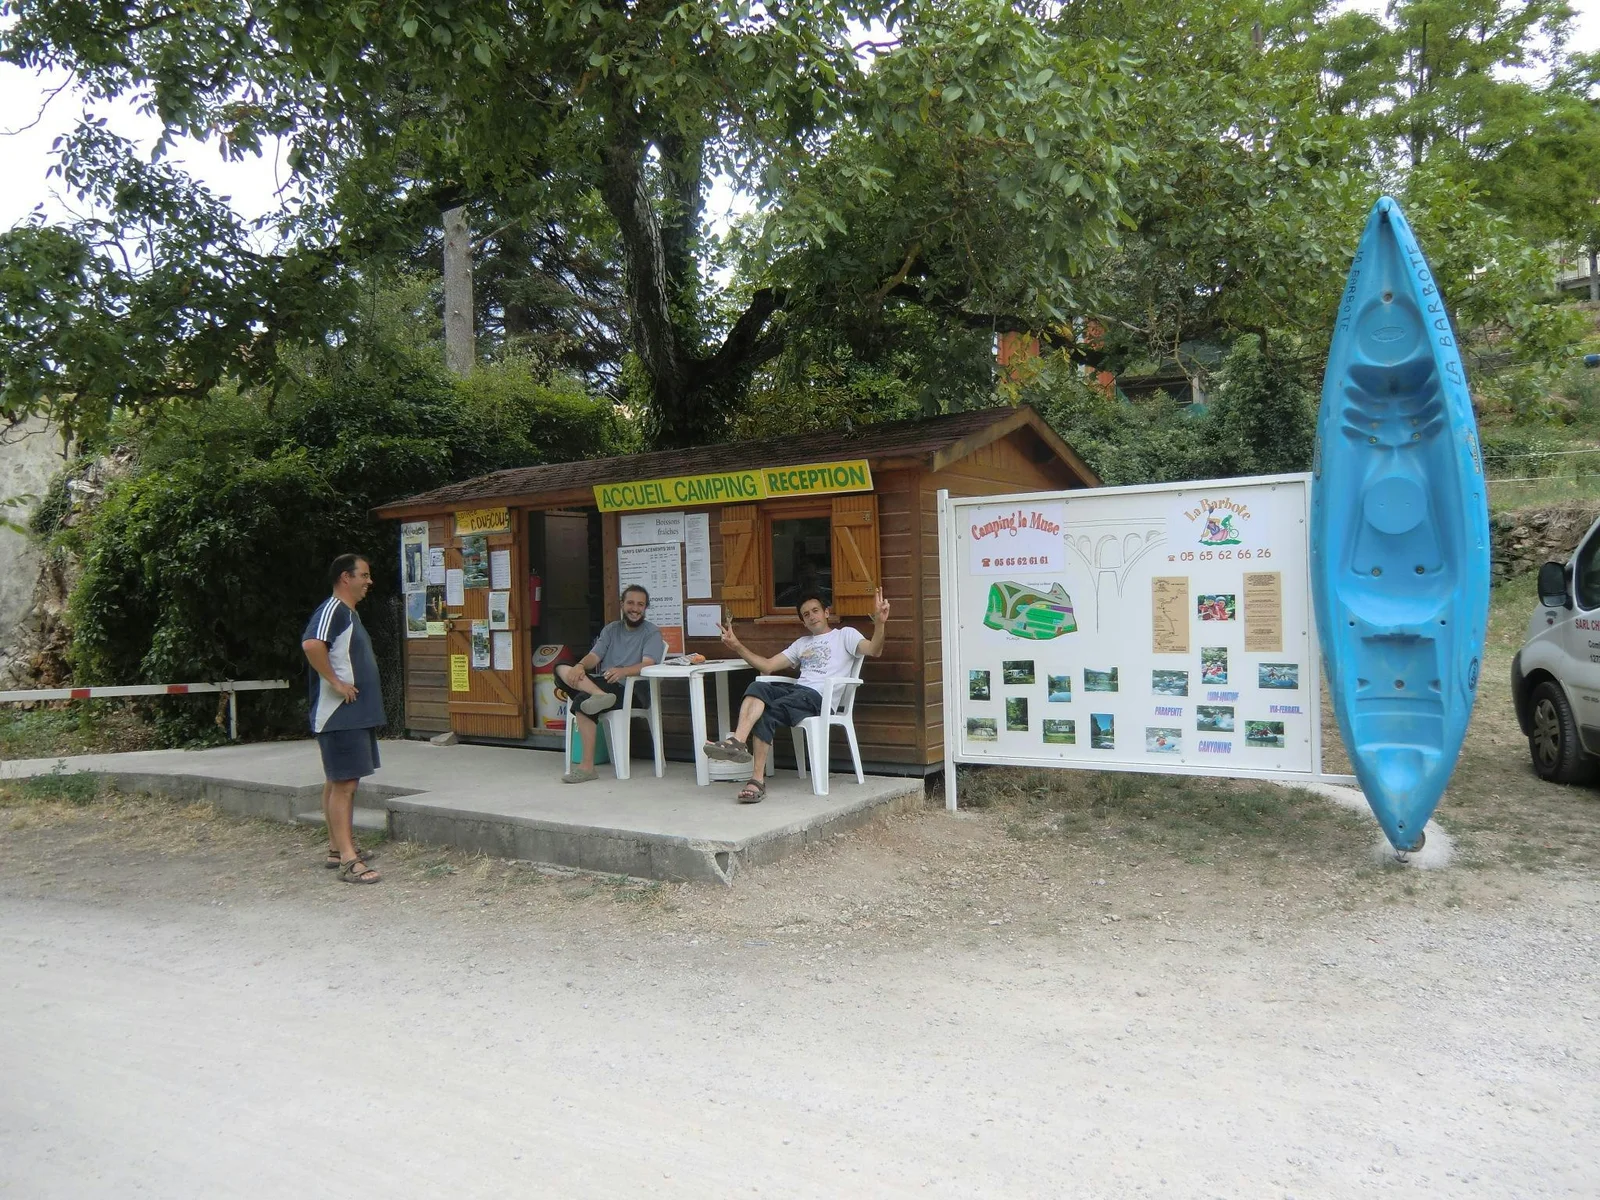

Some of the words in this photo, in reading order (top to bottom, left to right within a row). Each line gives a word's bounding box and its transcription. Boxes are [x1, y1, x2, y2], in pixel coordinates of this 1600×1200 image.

[1406, 243, 1453, 348] BARBOTE
[1444, 361, 1462, 386] LA
[767, 465, 867, 492] RECEPTION
[602, 484, 672, 509] ACCUEIL
[674, 473, 758, 502] CAMPING
[1183, 508, 1201, 523] La
[1200, 497, 1251, 522] Barbote
[655, 518, 680, 526] Boissons
[971, 512, 1018, 541] Camping
[1031, 511, 1060, 536] Muse
[994, 558, 1004, 567] 05
[1006, 557, 1016, 566] 65
[1017, 557, 1028, 566] 62
[1029, 556, 1038, 565] 61
[1040, 556, 1048, 565] 61
[1180, 551, 1194, 561] 05
[1199, 550, 1213, 561] 65
[1218, 549, 1232, 560] 62
[1237, 549, 1251, 559] 66
[1257, 548, 1271, 558] 26
[1575, 618, 1590, 630] SARL
[1155, 706, 1183, 717] PARAPENTE
[1198, 740, 1232, 754] CANYONING
